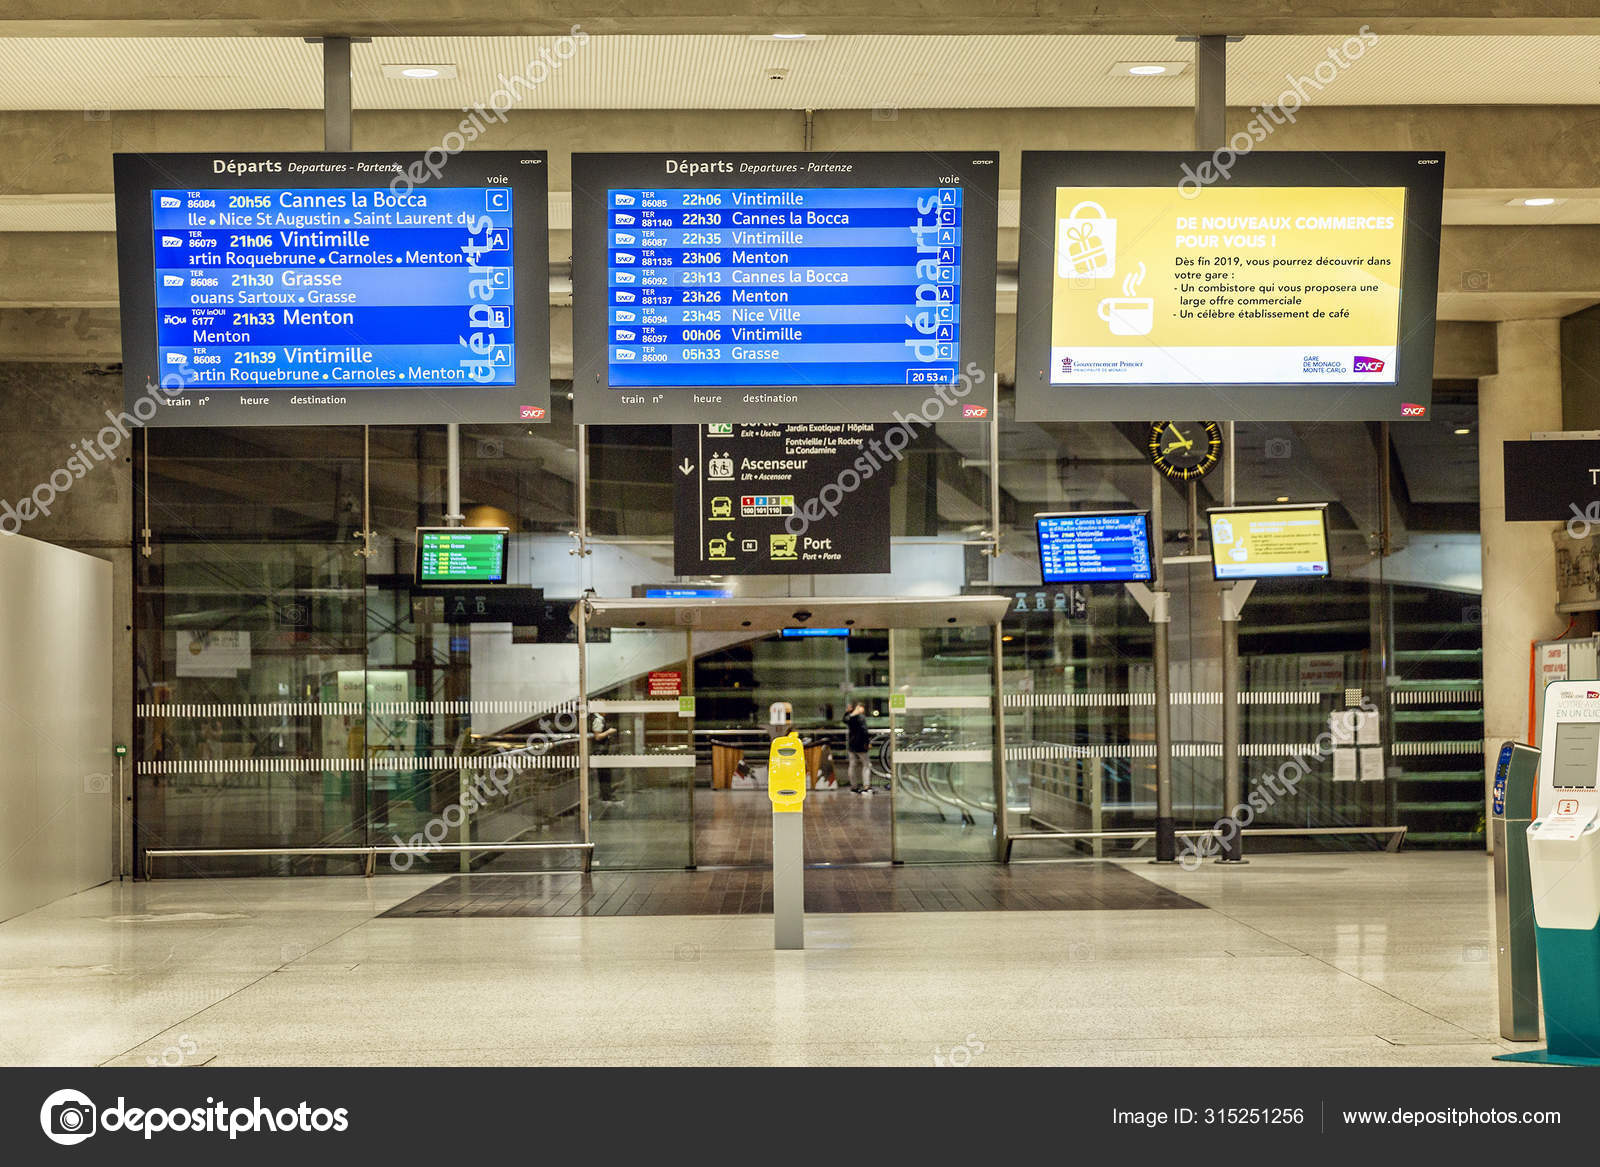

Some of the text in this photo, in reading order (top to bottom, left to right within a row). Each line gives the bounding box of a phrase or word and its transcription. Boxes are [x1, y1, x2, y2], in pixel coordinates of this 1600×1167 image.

[214, 160, 403, 175] Départs Departures Partenze
[667, 160, 852, 175] Départs Departures Partenze
[487, 175, 508, 183] voie
[939, 175, 959, 183] voie
[188, 191, 427, 208] 86084 20h56 Cannes la Bocca
[642, 192, 803, 208] 86085 22h06 Vintimille
[220, 212, 453, 228] Nice St Augustin Saint Laurent
[642, 211, 848, 227] 881140 22h30 Cannes la Bocca
[1176, 216, 1394, 230] DE NOUVEAUX COMMERCES
[189, 231, 369, 247] 86079 21h06 Vintimille
[641, 231, 803, 247] 86087 22h35 Vintimille
[1176, 235, 1266, 248] POUR VOUS
[227, 250, 464, 269] Roquebrune Carnoles Menton
[683, 252, 721, 264] 23h06
[733, 251, 788, 263] Menton
[1176, 257, 1194, 266] Dès
[1198, 257, 1210, 265] fin
[1214, 257, 1242, 267] 2019,
[1273, 260, 1312, 268] pourrez
[1316, 257, 1364, 265] découvrir
[1367, 257, 1391, 265] dans
[191, 271, 342, 286] 86086 21h30 Grasse
[641, 270, 848, 285] 86092 23h13 Cannes la Bocca
[905, 194, 951, 363] départs
[1205, 273, 1228, 281] gare
[1181, 284, 1194, 292] Un
[1199, 283, 1255, 292] combistore
[1259, 283, 1274, 294] qui
[1305, 286, 1356, 294] proposera
[239, 290, 356, 304] Sartoux Grasse
[460, 215, 504, 382] départs
[683, 291, 721, 302] 23h26
[733, 290, 788, 302] Menton
[1181, 296, 1301, 307] large offre commerciale
[192, 310, 353, 325] 6177 21h33 Menton
[641, 308, 800, 324] 86094 23h45 Nice Ville
[1180, 309, 1349, 318] Un célèbre établissement de café
[194, 330, 250, 342] Menton
[642, 328, 802, 343] 86097 00h06 Vintimille
[193, 348, 372, 364] 86083 21h39 Vintimille
[641, 347, 779, 362] 86000 05h33 Grasse
[231, 367, 464, 384] Roquebrune Carnoles Menton
[913, 373, 938, 381] 20 53
[168, 395, 346, 406] train heure destination
[622, 395, 644, 403] train
[743, 394, 797, 402] destination
[521, 410, 543, 418] SNCF
[964, 409, 986, 417] SNCF
[1402, 407, 1424, 415] SNCF
[809, 424, 840, 433] Exotique
[848, 424, 874, 433] Hôpital
[838, 438, 863, 446] Rocher
[741, 458, 807, 469] Ascenseur
[804, 538, 831, 549] Port
